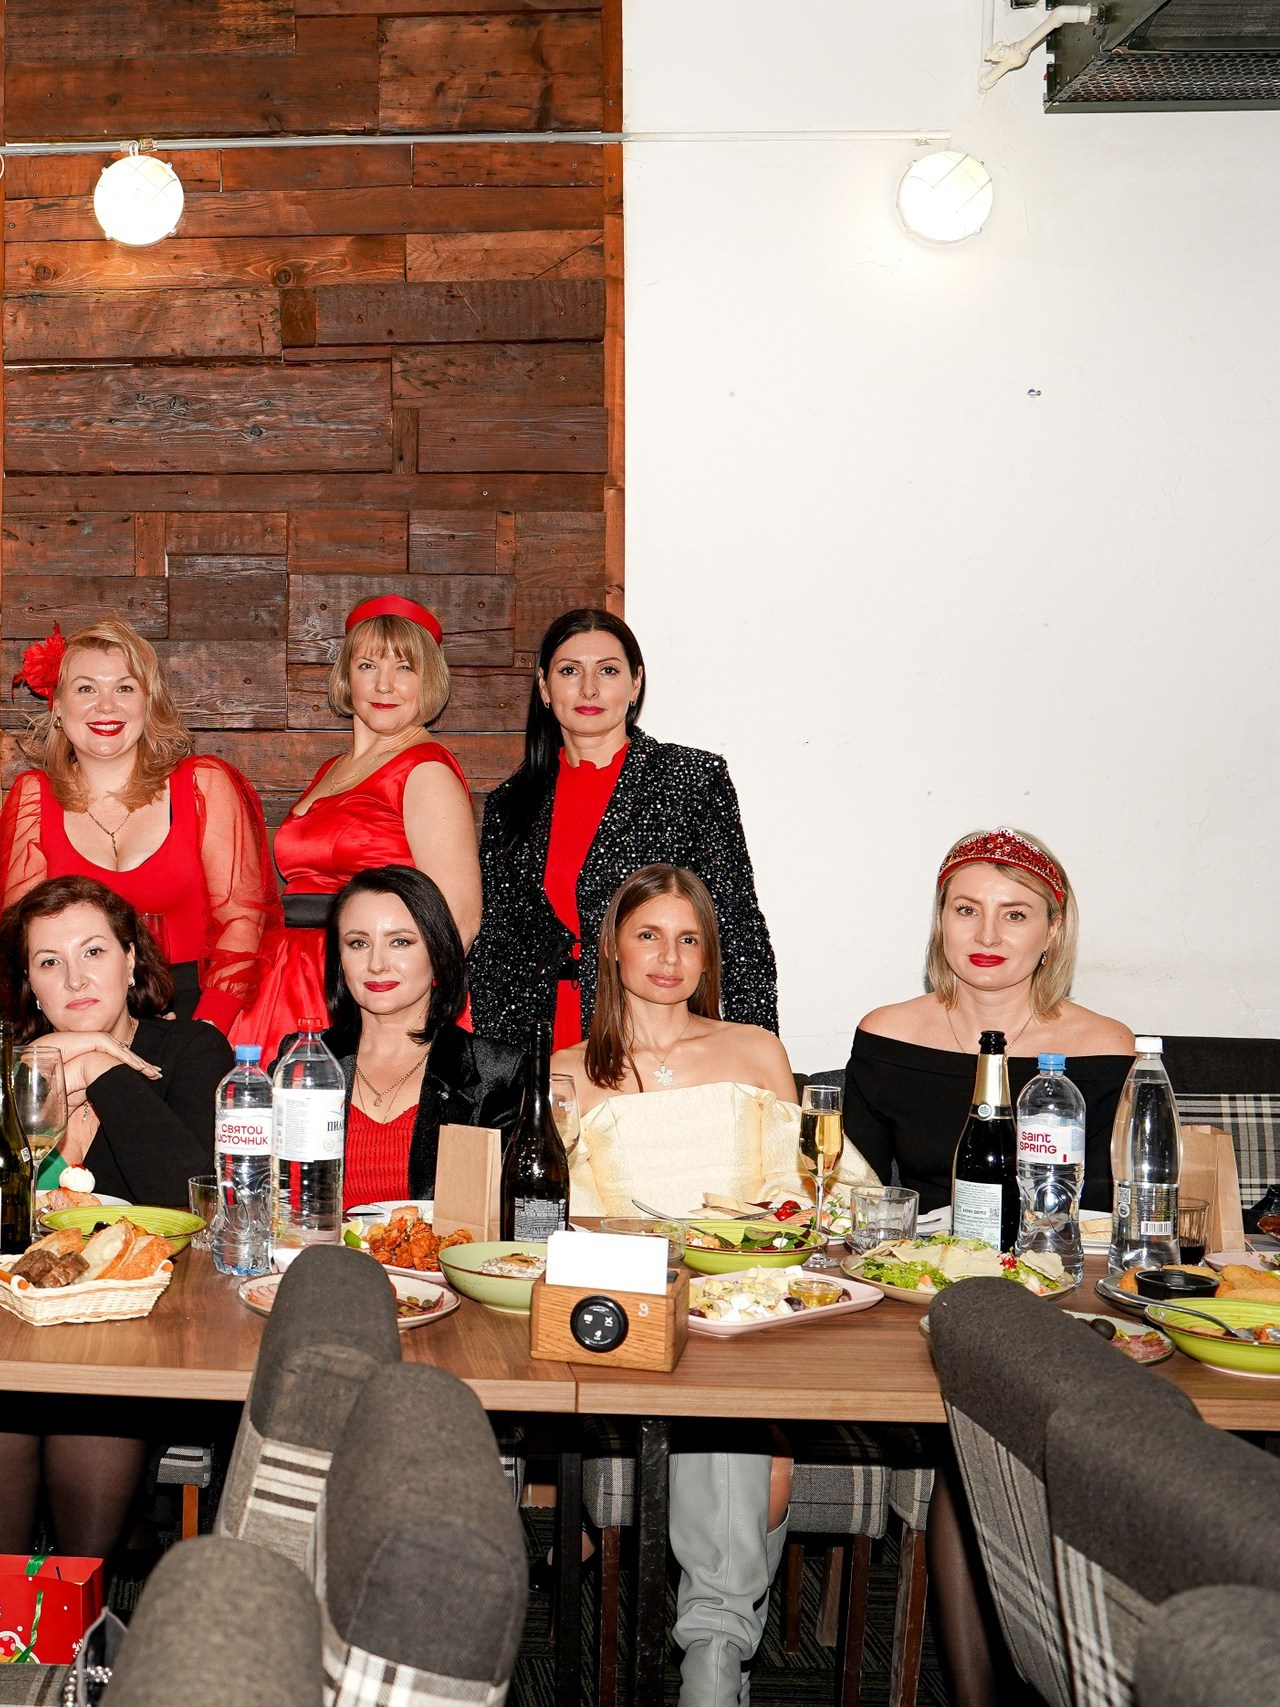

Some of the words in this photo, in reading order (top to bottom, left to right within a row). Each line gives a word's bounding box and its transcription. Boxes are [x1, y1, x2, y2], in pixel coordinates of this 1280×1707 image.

[221, 1123, 263, 1135] СВЯТОЙ
[327, 1120, 344, 1132] ПИЛ
[217, 1134, 269, 1146] ИСТОЧНИК
[638, 1303, 649, 1317] 9
